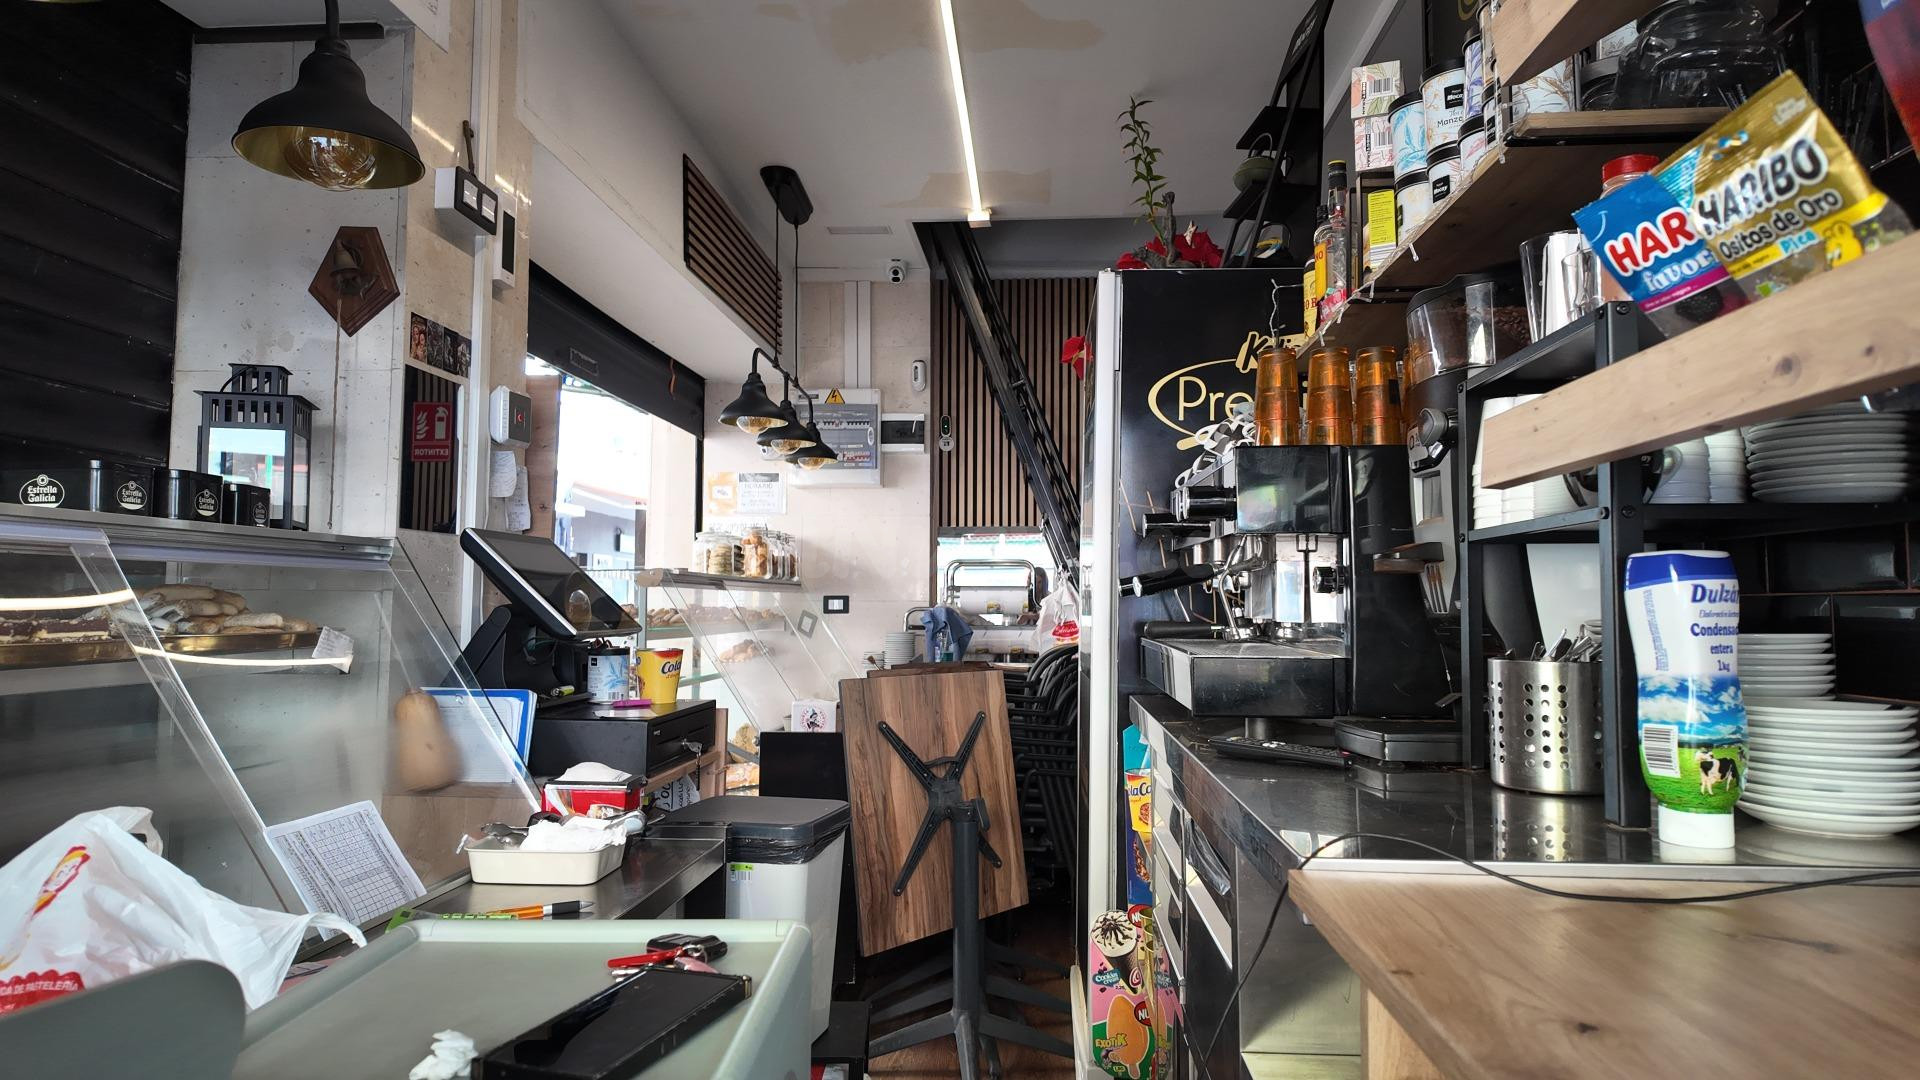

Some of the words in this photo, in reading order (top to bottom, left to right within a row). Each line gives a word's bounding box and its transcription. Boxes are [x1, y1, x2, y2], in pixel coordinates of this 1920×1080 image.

[1696, 136, 1830, 238] HARIBO
[1719, 222, 1773, 260] Ositos
[1775, 209, 1801, 233] de
[1797, 190, 1841, 221] Oro
[1778, 230, 1818, 254] Pica
[27, 485, 58, 495] Estrella
[122, 489, 143, 498] Estrella
[28, 494, 56, 503] Galicia
[122, 495, 142, 504] Galicia
[1690, 583, 1739, 604] Dulzá
[1710, 643, 1734, 655] entera
